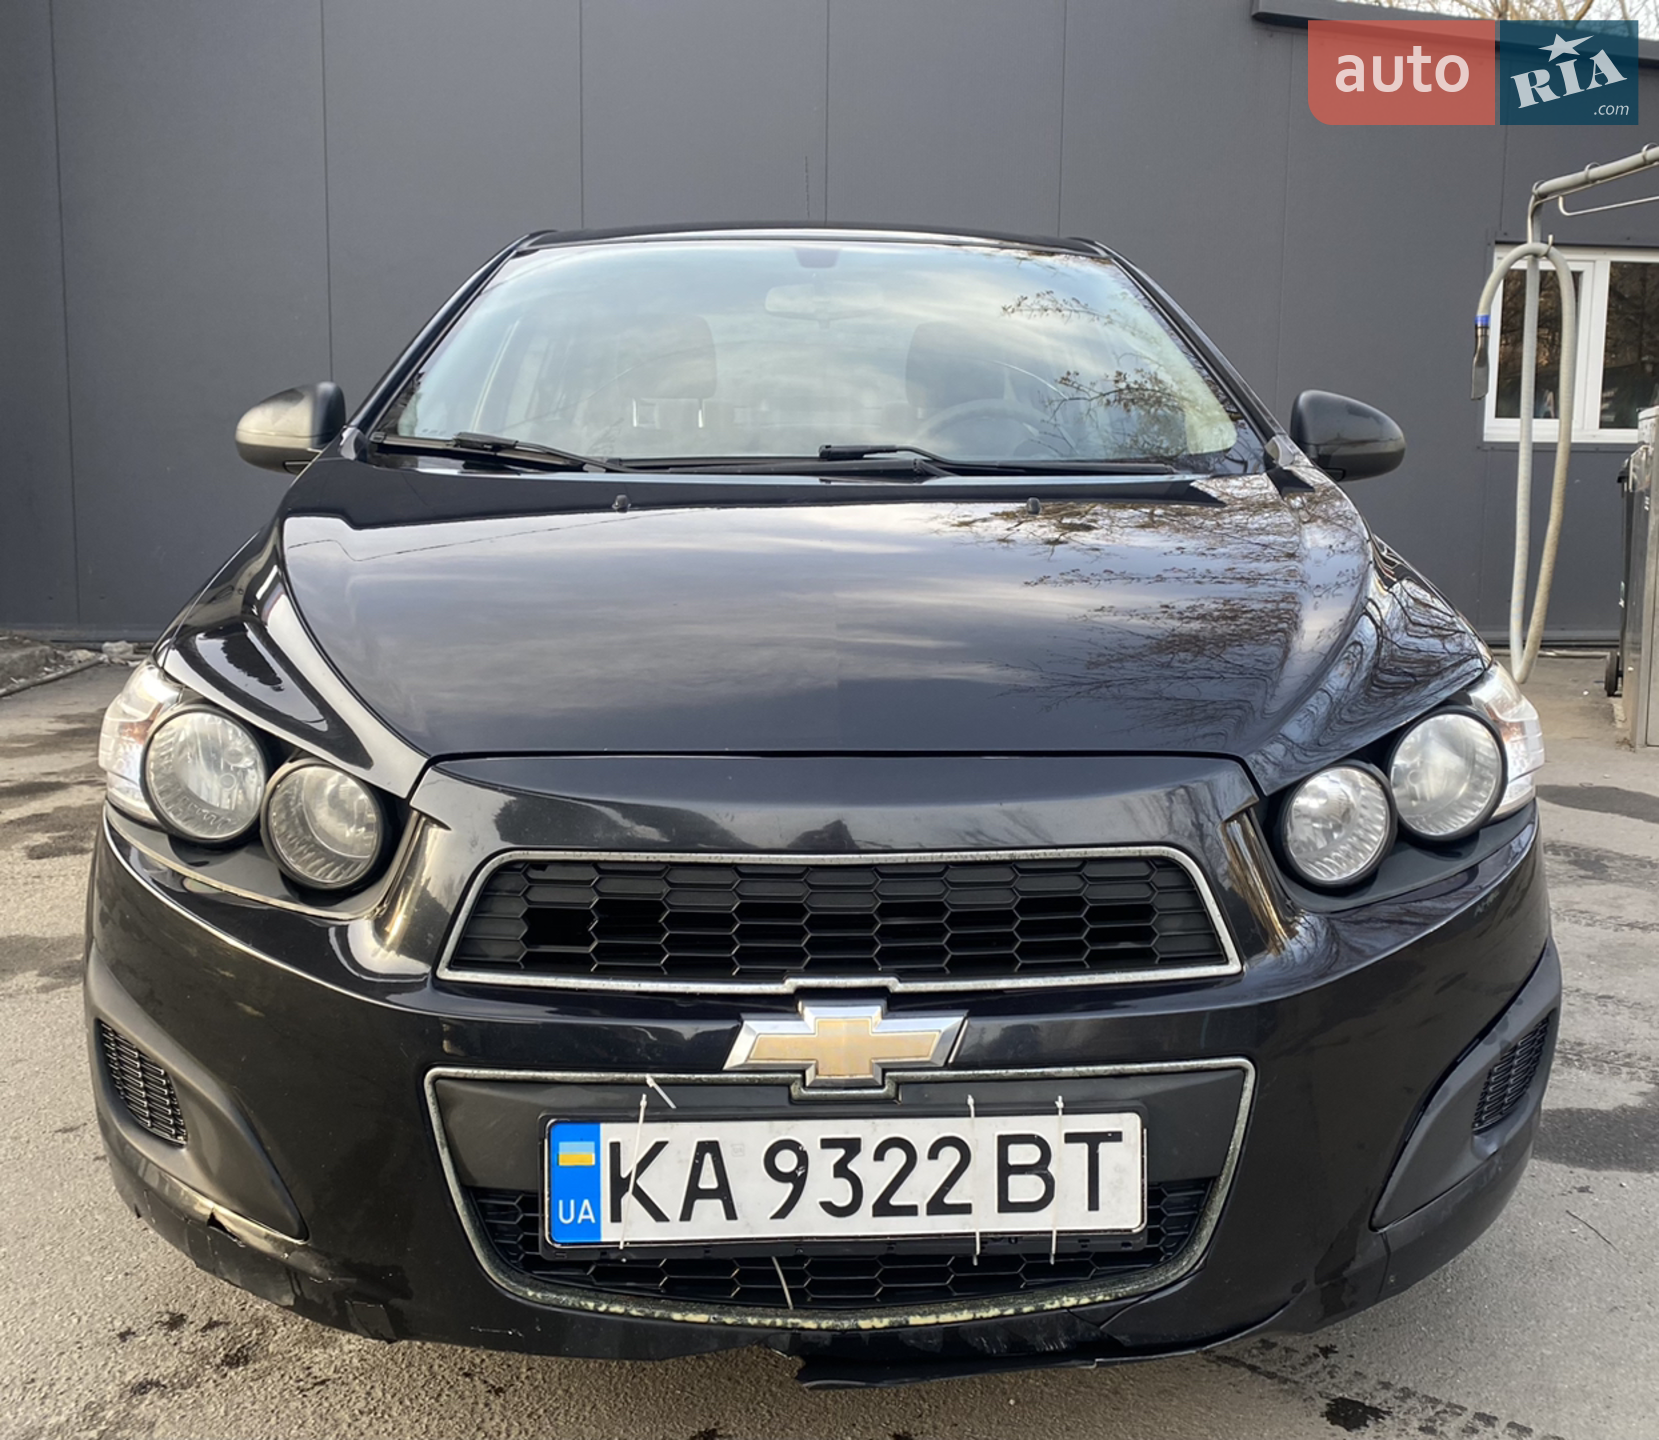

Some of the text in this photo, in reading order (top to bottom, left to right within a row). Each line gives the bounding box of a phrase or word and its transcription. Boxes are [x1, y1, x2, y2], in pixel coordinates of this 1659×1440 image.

[608, 1131, 1123, 1223] KA 9322 BT
[558, 1199, 596, 1224] UA
